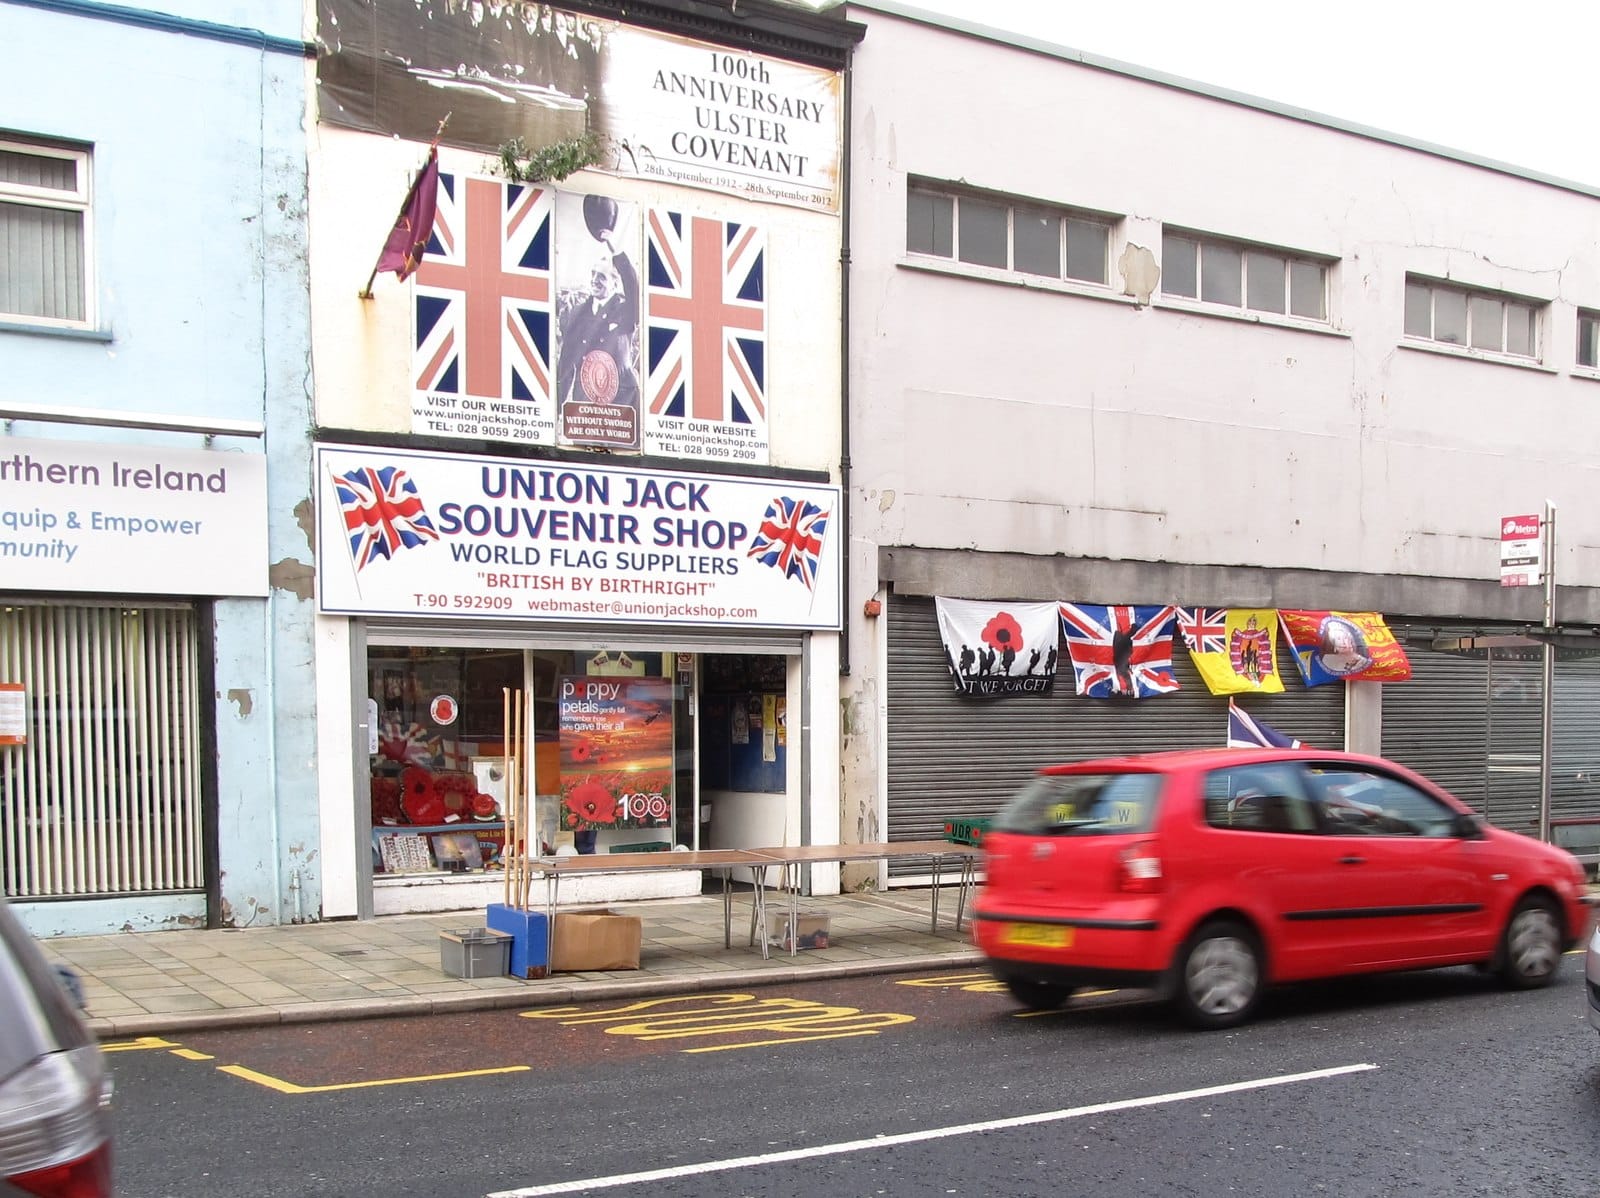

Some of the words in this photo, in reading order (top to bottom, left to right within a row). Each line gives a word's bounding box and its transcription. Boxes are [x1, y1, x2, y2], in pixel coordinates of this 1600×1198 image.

[710, 52, 771, 84] 100th
[652, 69, 825, 124] ANNIVERSARY
[694, 105, 789, 145] ULSTER
[670, 131, 809, 178] COVENANT
[643, 162, 665, 176] 28th
[666, 166, 714, 186] September
[715, 176, 737, 189] 1912
[744, 183, 765, 195] 28th
[766, 186, 810, 204] September
[810, 193, 833, 206] 2012
[427, 396, 458, 408] VISIT
[461, 400, 487, 412] OUR
[490, 402, 541, 417] WEBSITE
[578, 405, 623, 417] COVENANTS
[412, 407, 555, 429] www.unionjackshop.com
[565, 415, 604, 426] WITHOUT
[604, 418, 634, 429] SWORDS
[657, 419, 685, 431] VISIT
[688, 423, 711, 434] OUR
[712, 425, 757, 438] WEBSITE
[428, 421, 454, 432] TEL:
[457, 423, 479, 435] 028
[481, 426, 510, 438] 9059
[512, 429, 541, 440] 2909
[567, 426, 585, 436] ARE
[585, 428, 606, 437] ONLY
[606, 429, 632, 440] WORDS
[644, 429, 769, 450] www.unionjackshop.com
[658, 442, 681, 453] TEL:
[684, 445, 703, 455] 028
[705, 447, 731, 458] 9059
[732, 449, 757, 460] 2909
[112, 461, 226, 494] Ireland
[481, 466, 610, 505] UNION
[622, 477, 710, 512] JACK
[66, 511, 82, 529] &
[91, 511, 202, 536] Empower
[438, 502, 641, 545] SOUVENIR
[652, 516, 748, 550] SHOP
[1515, 525, 1537, 534] Metro
[450, 542, 541, 566] WORLD
[550, 549, 608, 570] FLAG
[615, 551, 740, 576] SUPPLIERS
[477, 571, 565, 591] "BRITISH
[571, 577, 594, 592] BY
[600, 578, 716, 597] BIRTHRIGHT"
[413, 593, 449, 609] T:90
[453, 596, 513, 611] 592909
[527, 599, 758, 620] webmaster@unionjackshop.com
[562, 700, 598, 716] petals
[574, 722, 595, 732] gave
[952, 823, 971, 839] UDR
